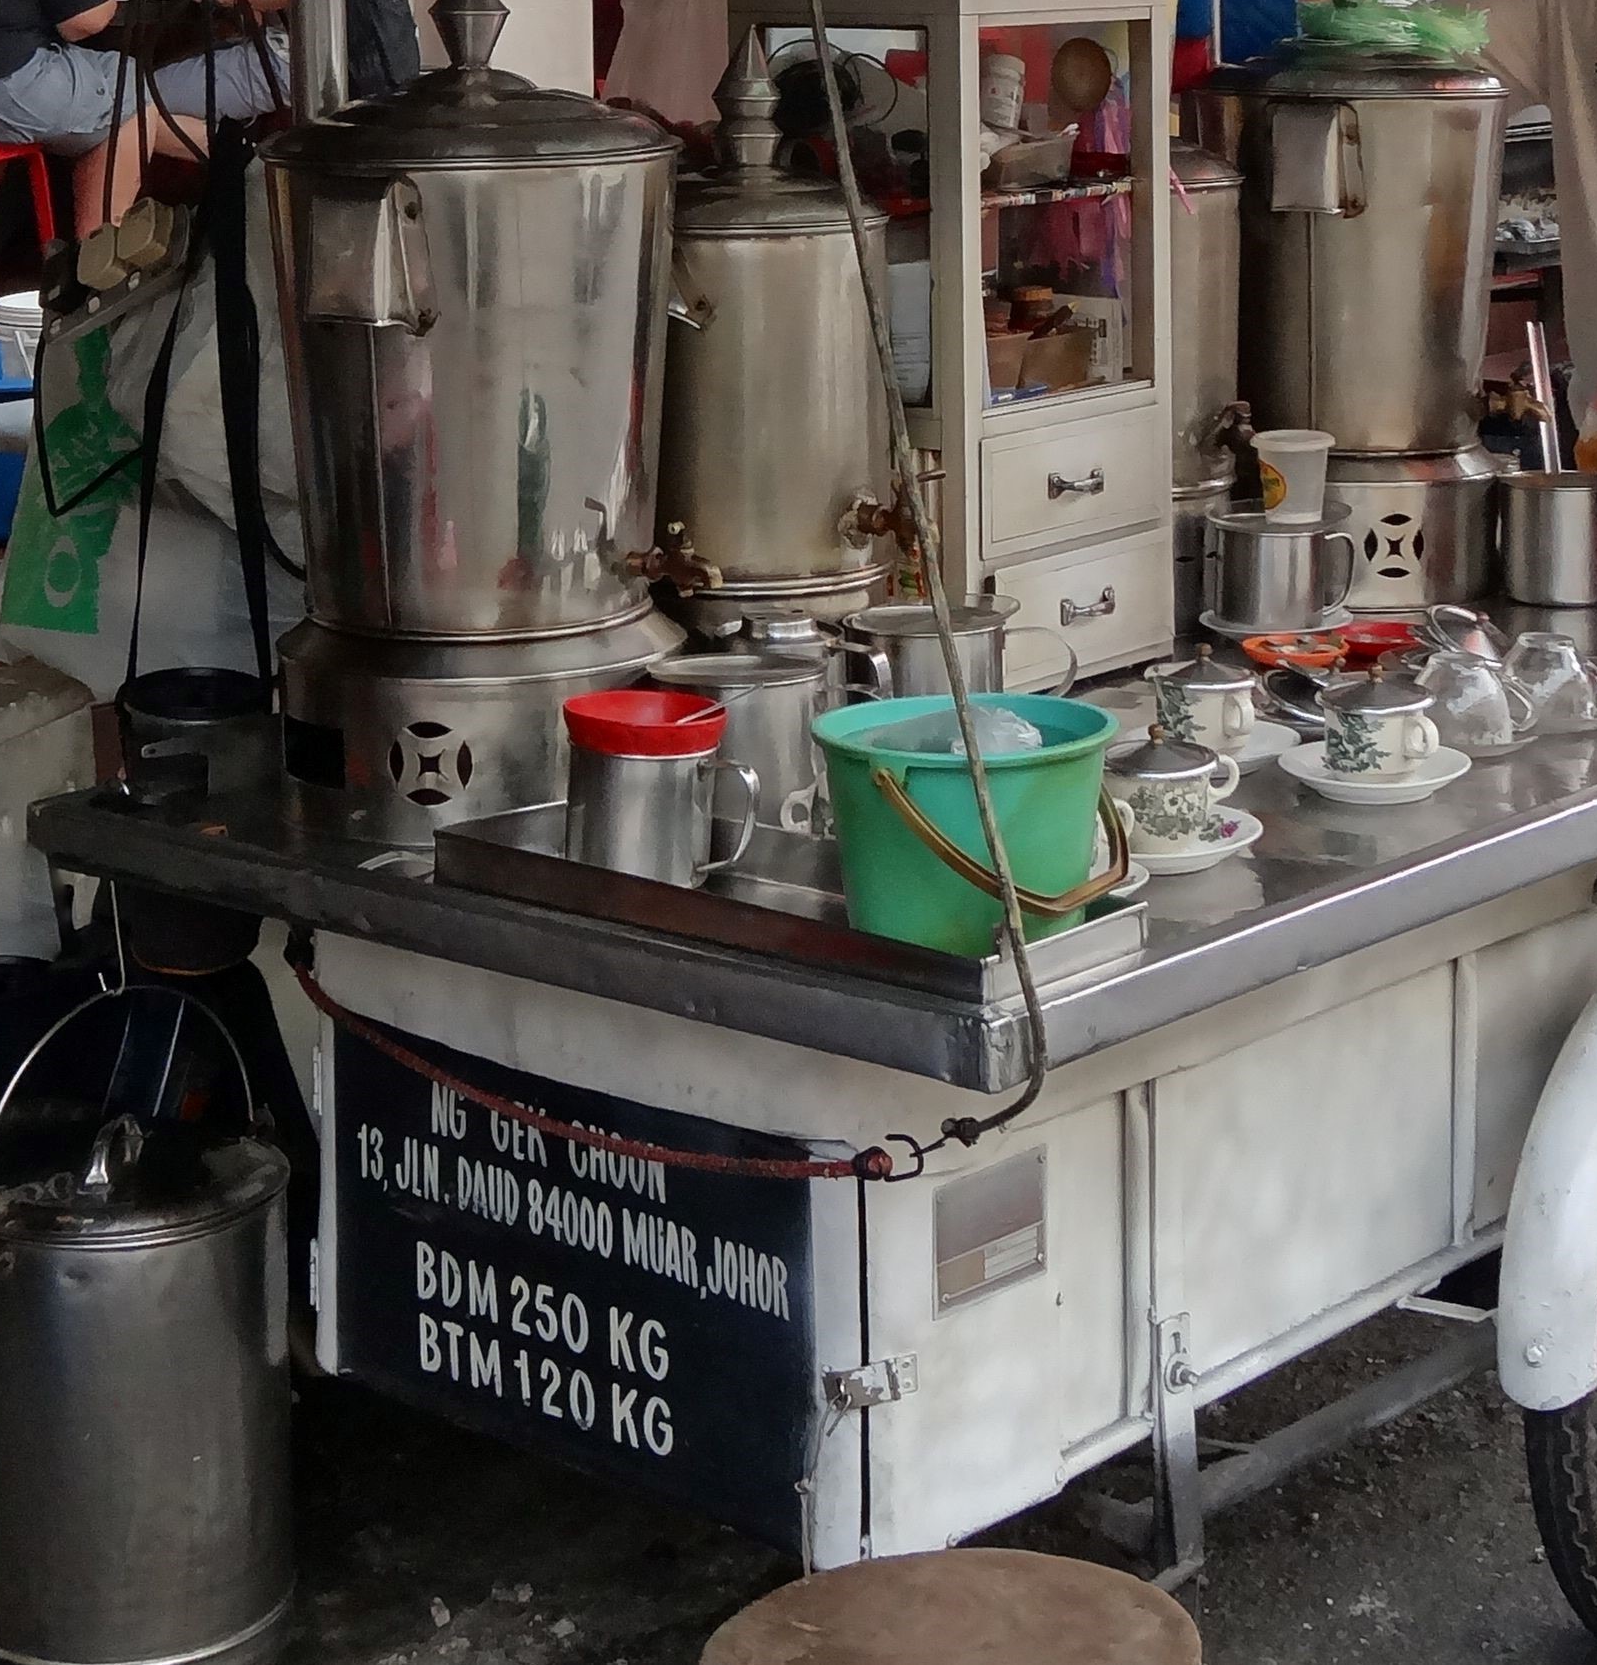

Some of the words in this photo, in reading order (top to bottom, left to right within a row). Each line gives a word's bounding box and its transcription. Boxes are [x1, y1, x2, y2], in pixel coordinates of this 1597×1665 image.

[431, 1081, 467, 1140] NG
[458, 1156, 520, 1226] DAUD
[528, 1179, 613, 1258] 84000
[416, 1241, 498, 1324] BDM
[511, 1275, 589, 1354] 250
[609, 1306, 670, 1381] KG
[419, 1312, 503, 1398] BTM
[514, 1349, 595, 1432] 120
[612, 1382, 674, 1457] KG
